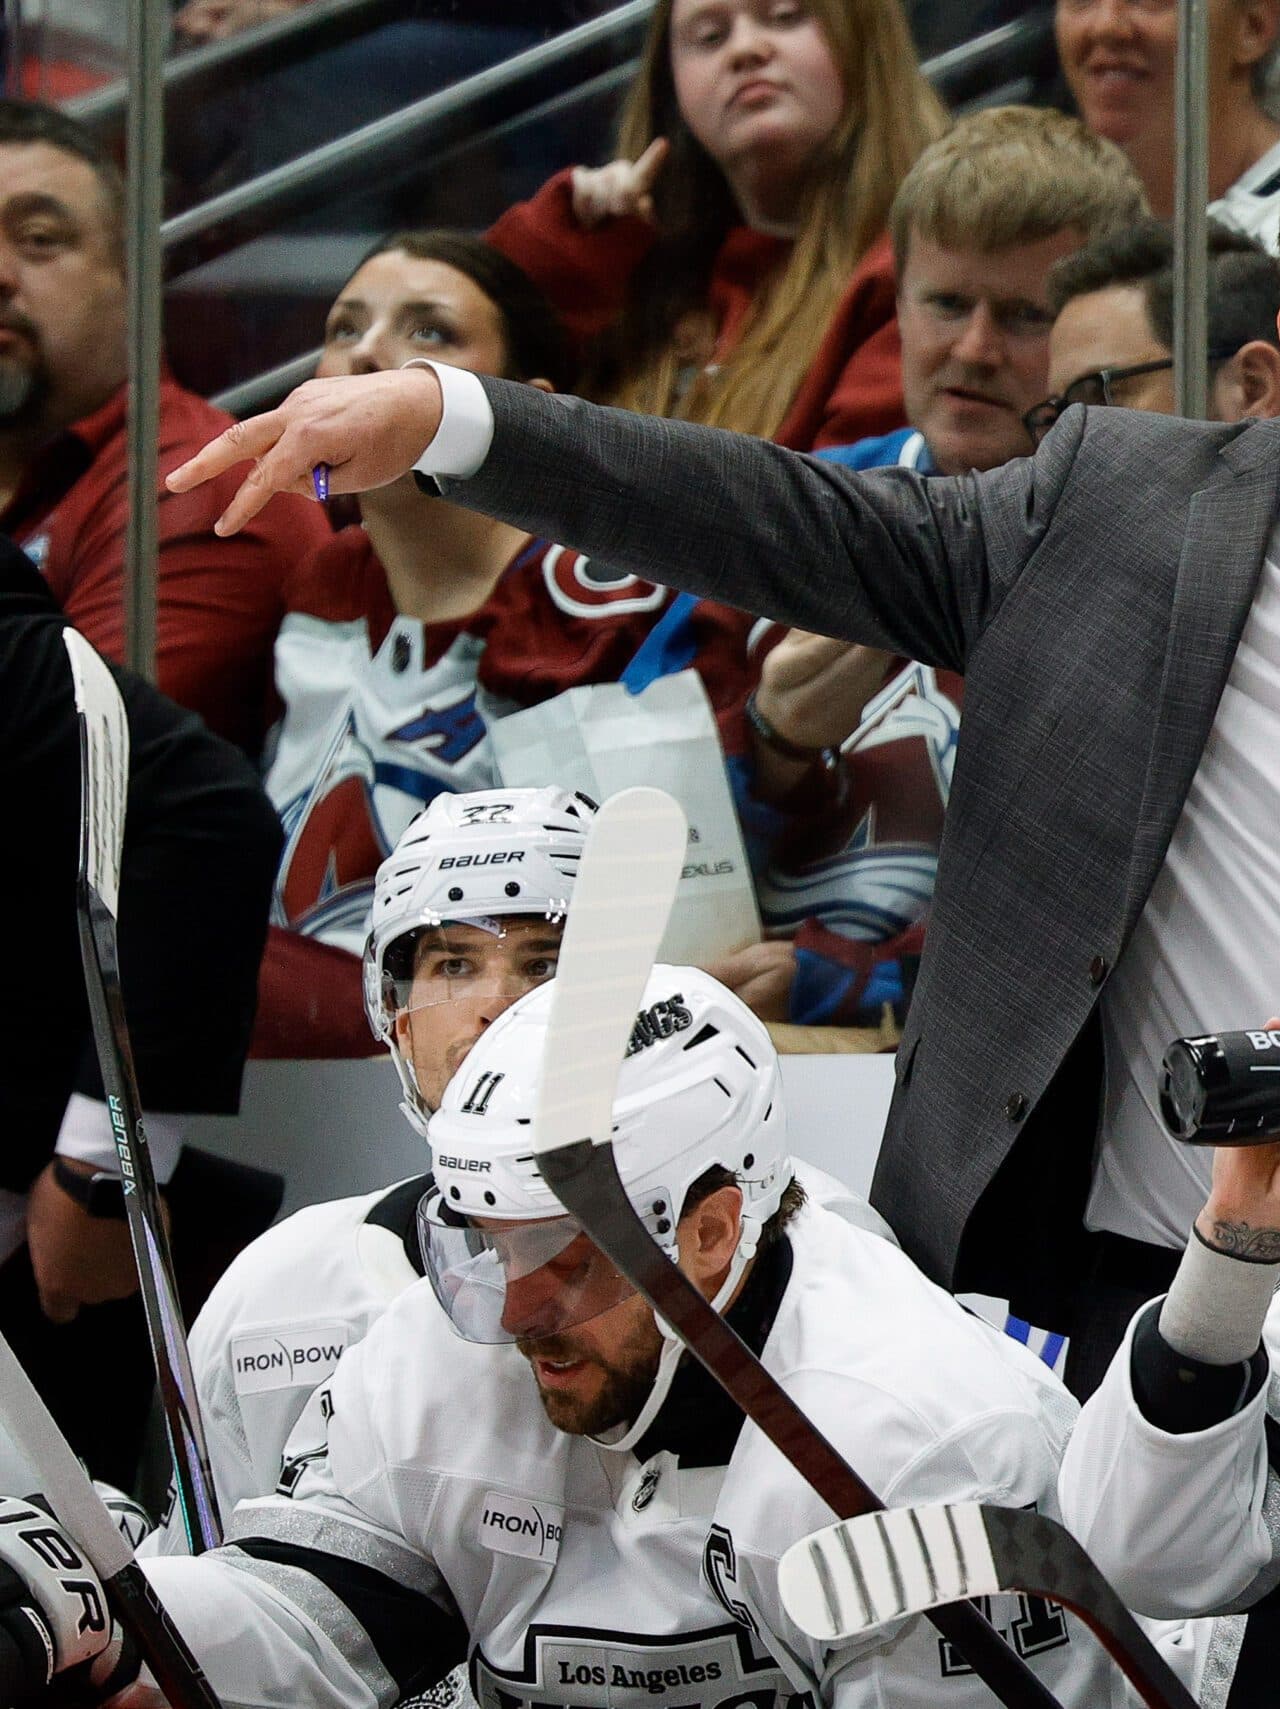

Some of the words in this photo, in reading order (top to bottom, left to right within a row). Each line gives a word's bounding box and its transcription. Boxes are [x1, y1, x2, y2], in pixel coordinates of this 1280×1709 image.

[438, 851, 525, 870] BAUER
[680, 861, 735, 880] EXUS
[623, 993, 693, 1059] NGS
[460, 1071, 505, 1116] 11
[108, 1094, 135, 1178] BAUER
[439, 1155, 491, 1173] BAUER
[237, 1352, 283, 1373] IRON
[293, 1344, 343, 1364] BOW
[483, 1509, 538, 1536] IRON
[546, 1524, 562, 1542] BO
[558, 1661, 605, 1685] Los
[611, 1662, 722, 1694] Angeles
